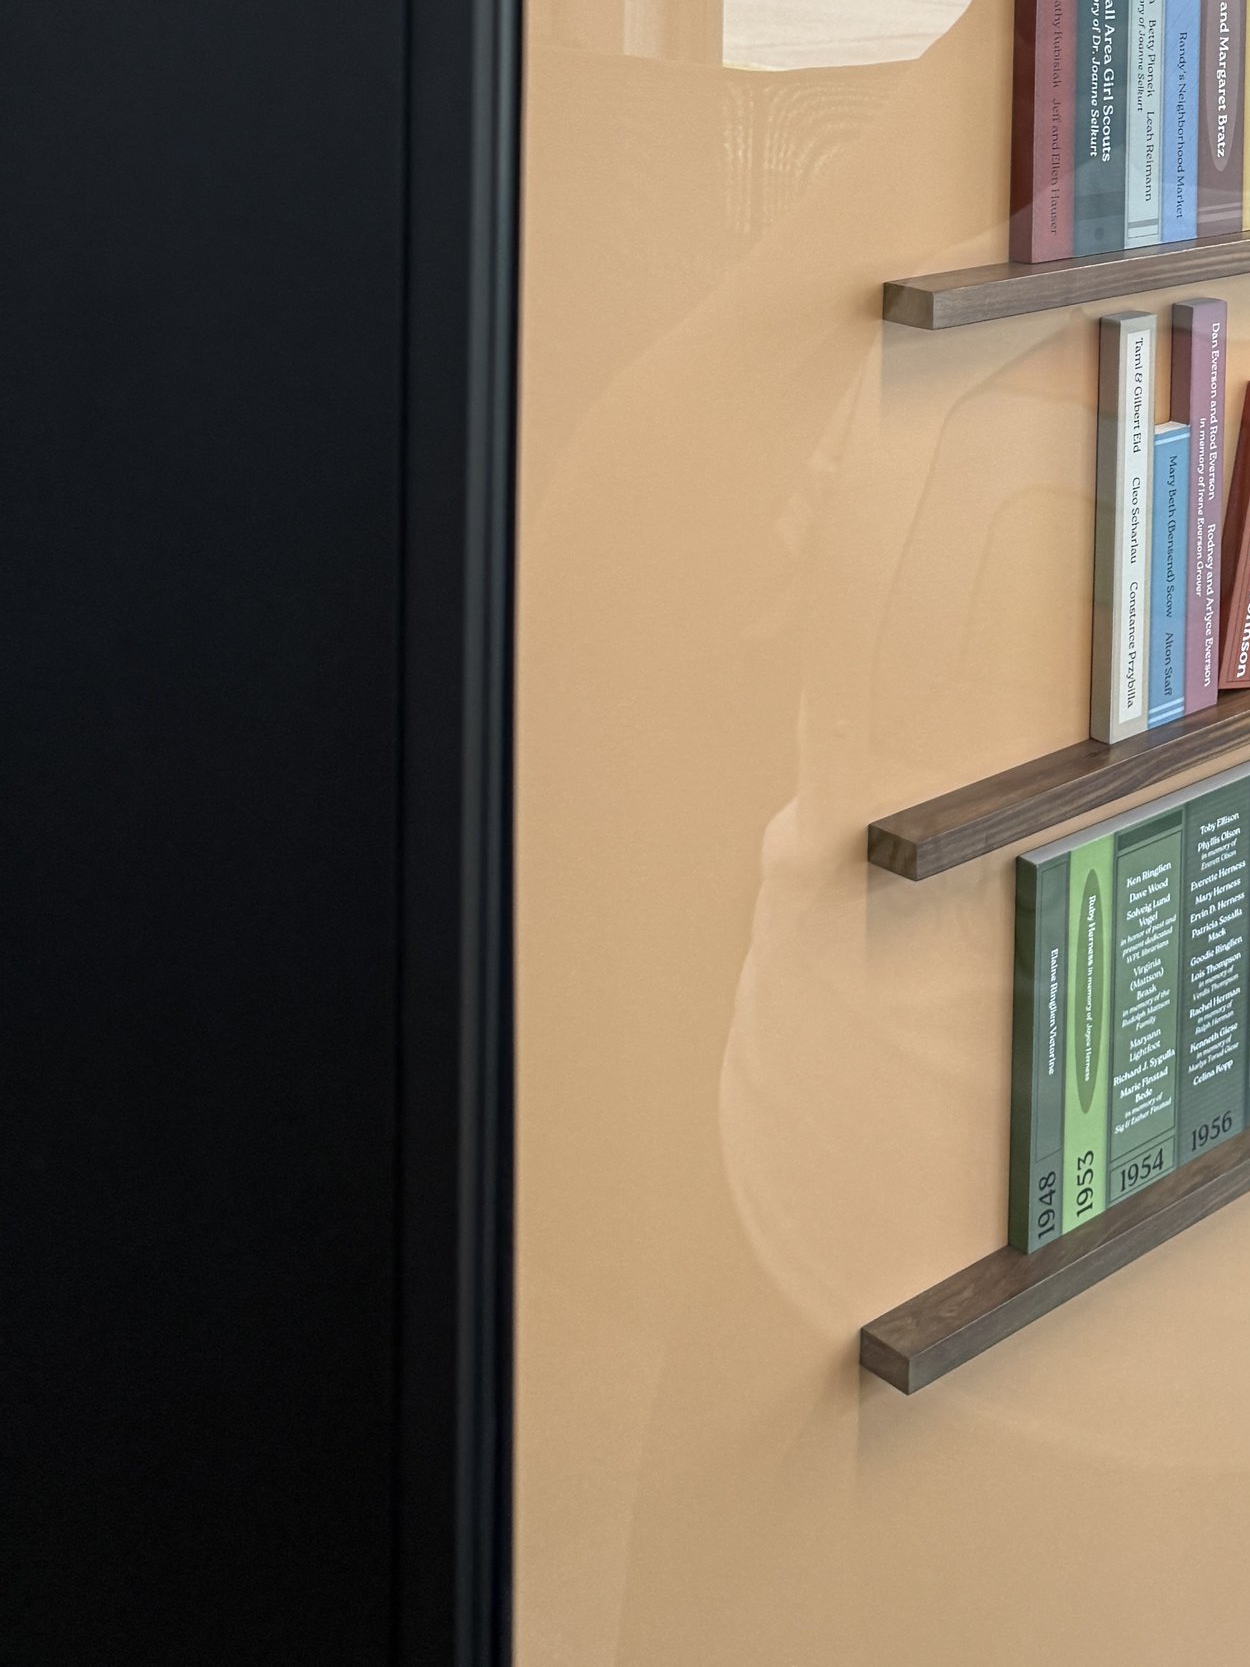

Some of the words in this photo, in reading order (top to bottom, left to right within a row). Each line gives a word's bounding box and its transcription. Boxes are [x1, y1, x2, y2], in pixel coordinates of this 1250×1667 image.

[1218, 1, 1229, 33] and
[1103, 24, 1115, 65] Area
[1102, 67, 1114, 101] Girl
[1215, 36, 1229, 111] Margaret
[1101, 104, 1113, 162] Scouts
[1216, 114, 1227, 158] Bratz
[1133, 337, 1143, 370] Tami
[1133, 372, 1142, 383] &
[1132, 385, 1142, 430] Gilbert
[1132, 432, 1141, 453] Eid
[1199, 822, 1216, 835] Toby
[1216, 812, 1240, 828] Ellison
[1129, 889, 1148, 903] Dave
[1147, 877, 1169, 894] Wood
[1049, 948, 1058, 982] Elaine
[1048, 982, 1057, 1027] Ringlien
[1047, 1026, 1057, 1075] Victorine
[1191, 1110, 1232, 1151] 1956
[1076, 1149, 1094, 1216] 1953
[1120, 1148, 1164, 1191] 1954
[1037, 1170, 1056, 1238] 1948
